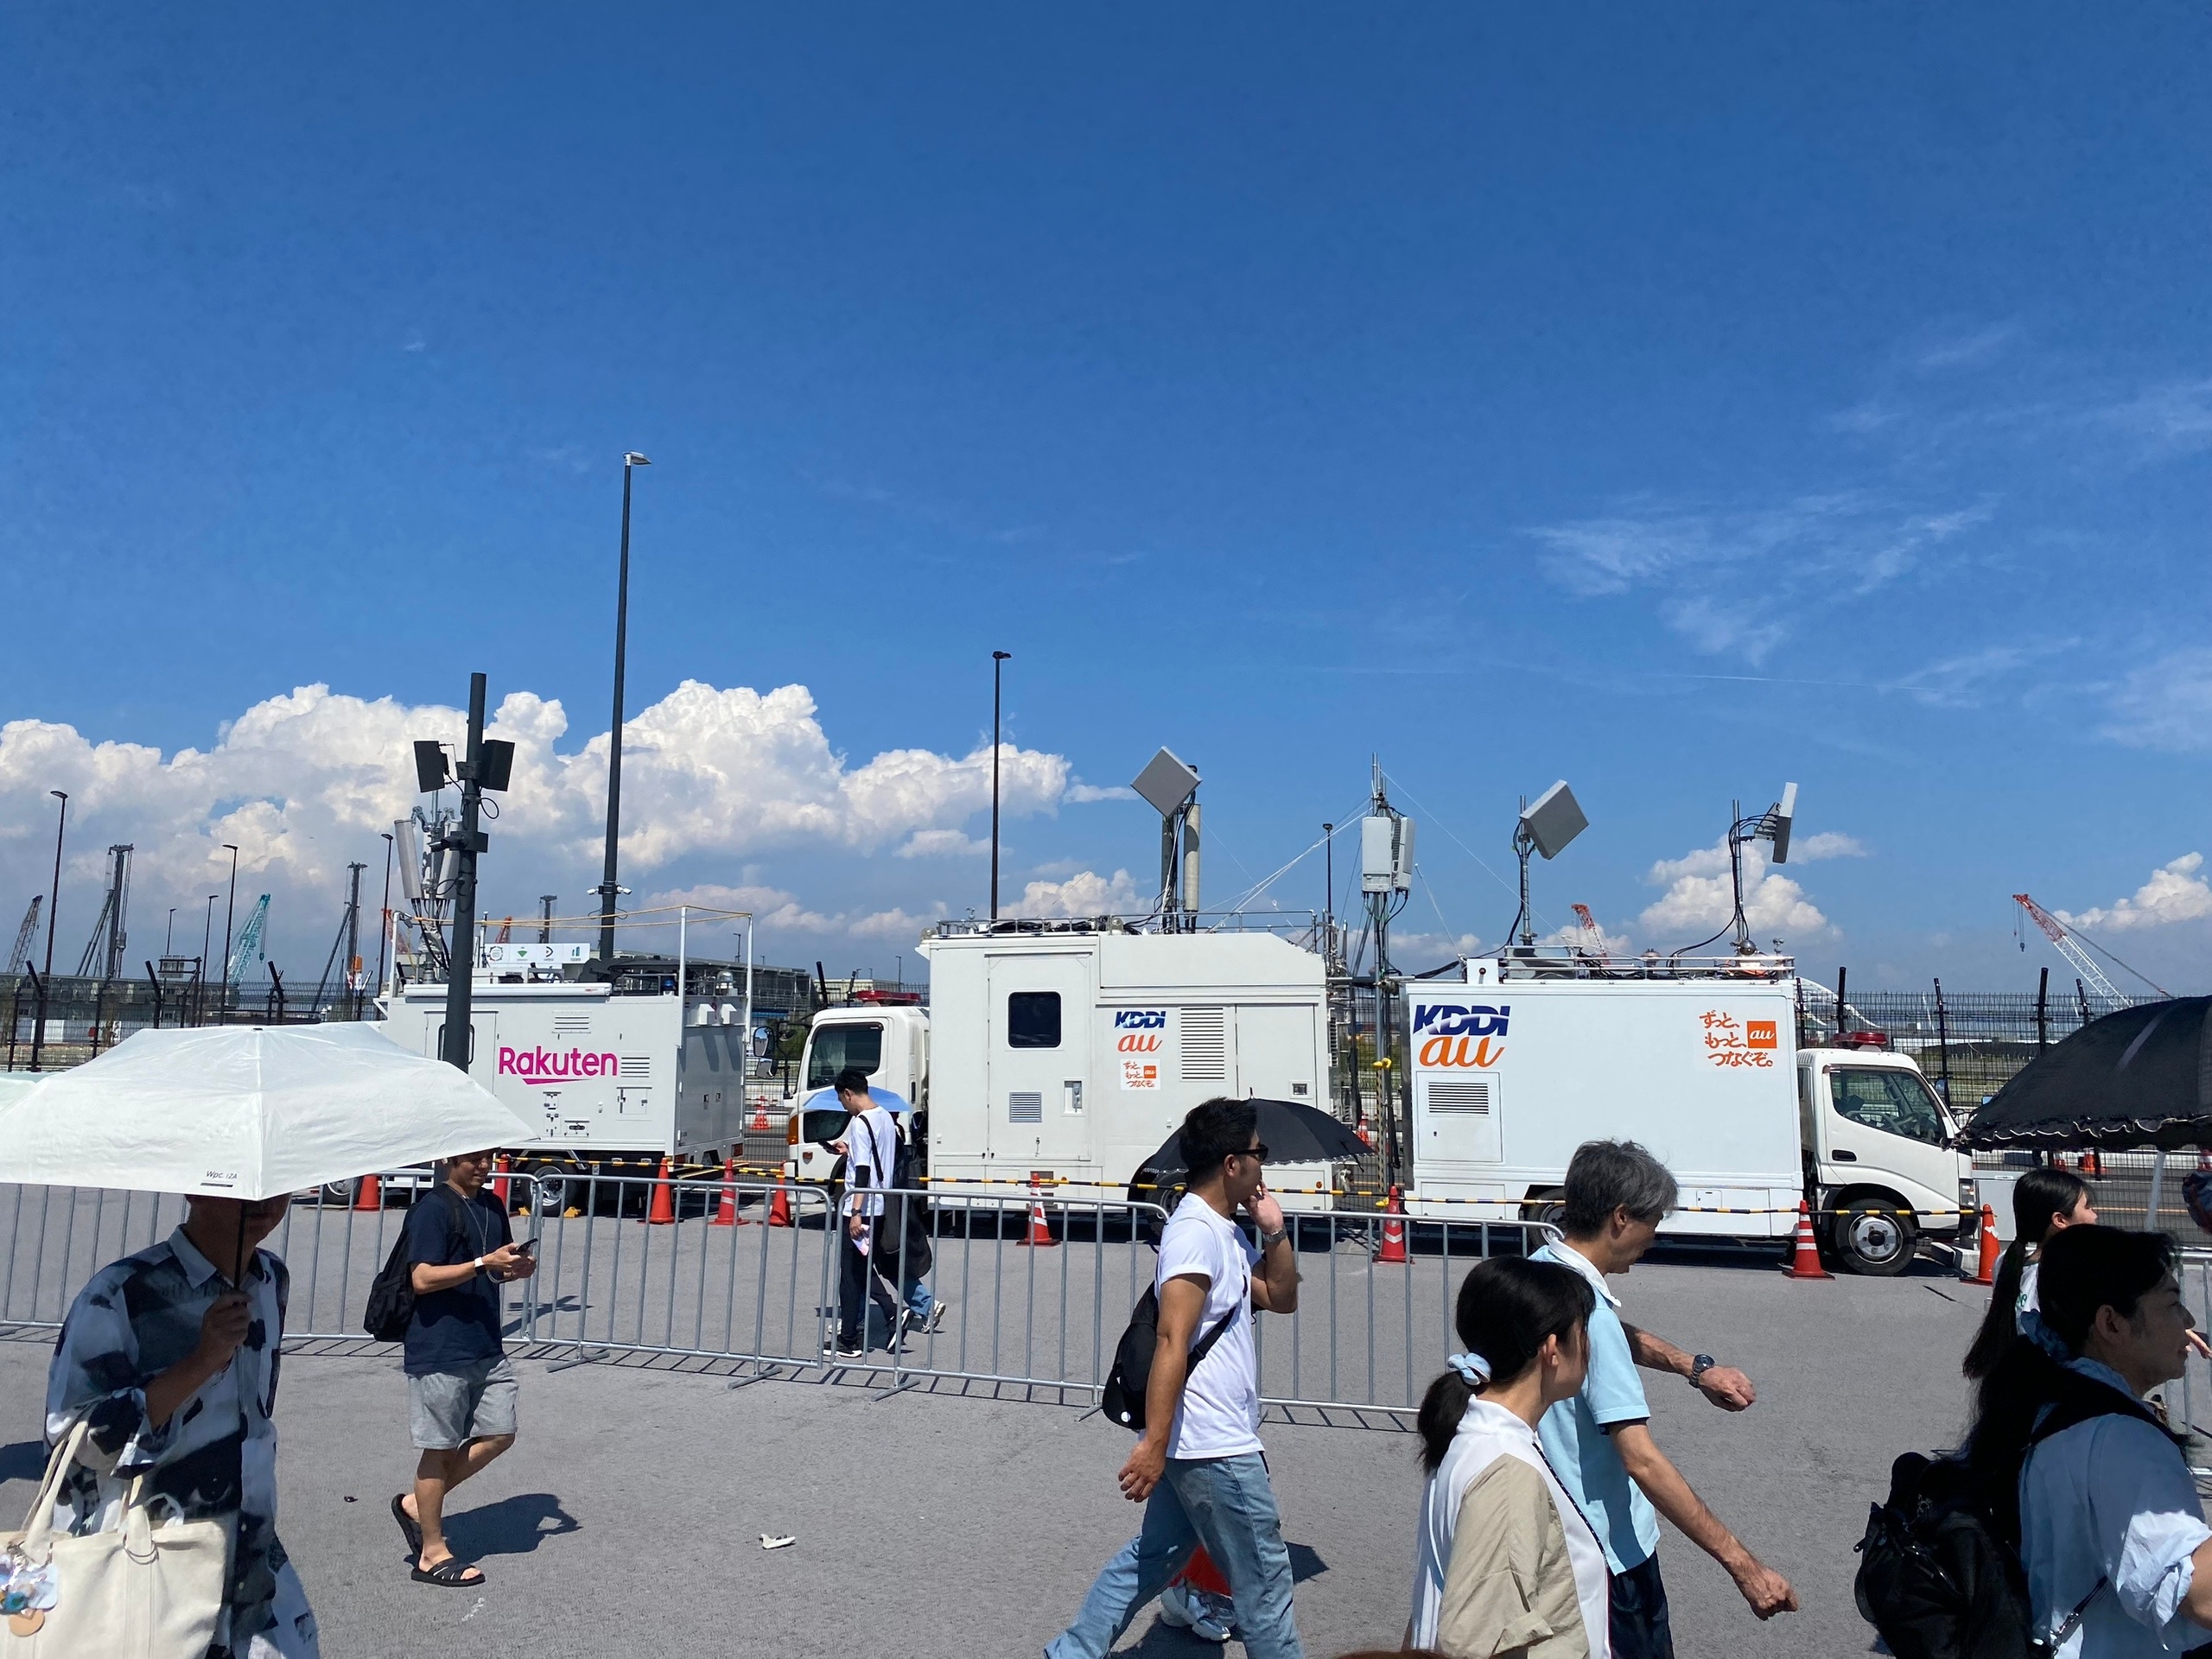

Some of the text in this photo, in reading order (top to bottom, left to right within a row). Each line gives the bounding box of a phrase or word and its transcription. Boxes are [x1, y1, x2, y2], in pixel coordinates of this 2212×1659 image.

[1115, 1011, 1166, 1028] KDDI
[1413, 1004, 1510, 1036] KDDI
[1699, 1009, 1740, 1029] ずっと、
[1117, 1034, 1162, 1052] au
[1705, 1032, 1746, 1049] もっと、
[1750, 1030, 1775, 1039] au
[499, 1046, 618, 1076] Rakuten
[1420, 1036, 1505, 1067] au
